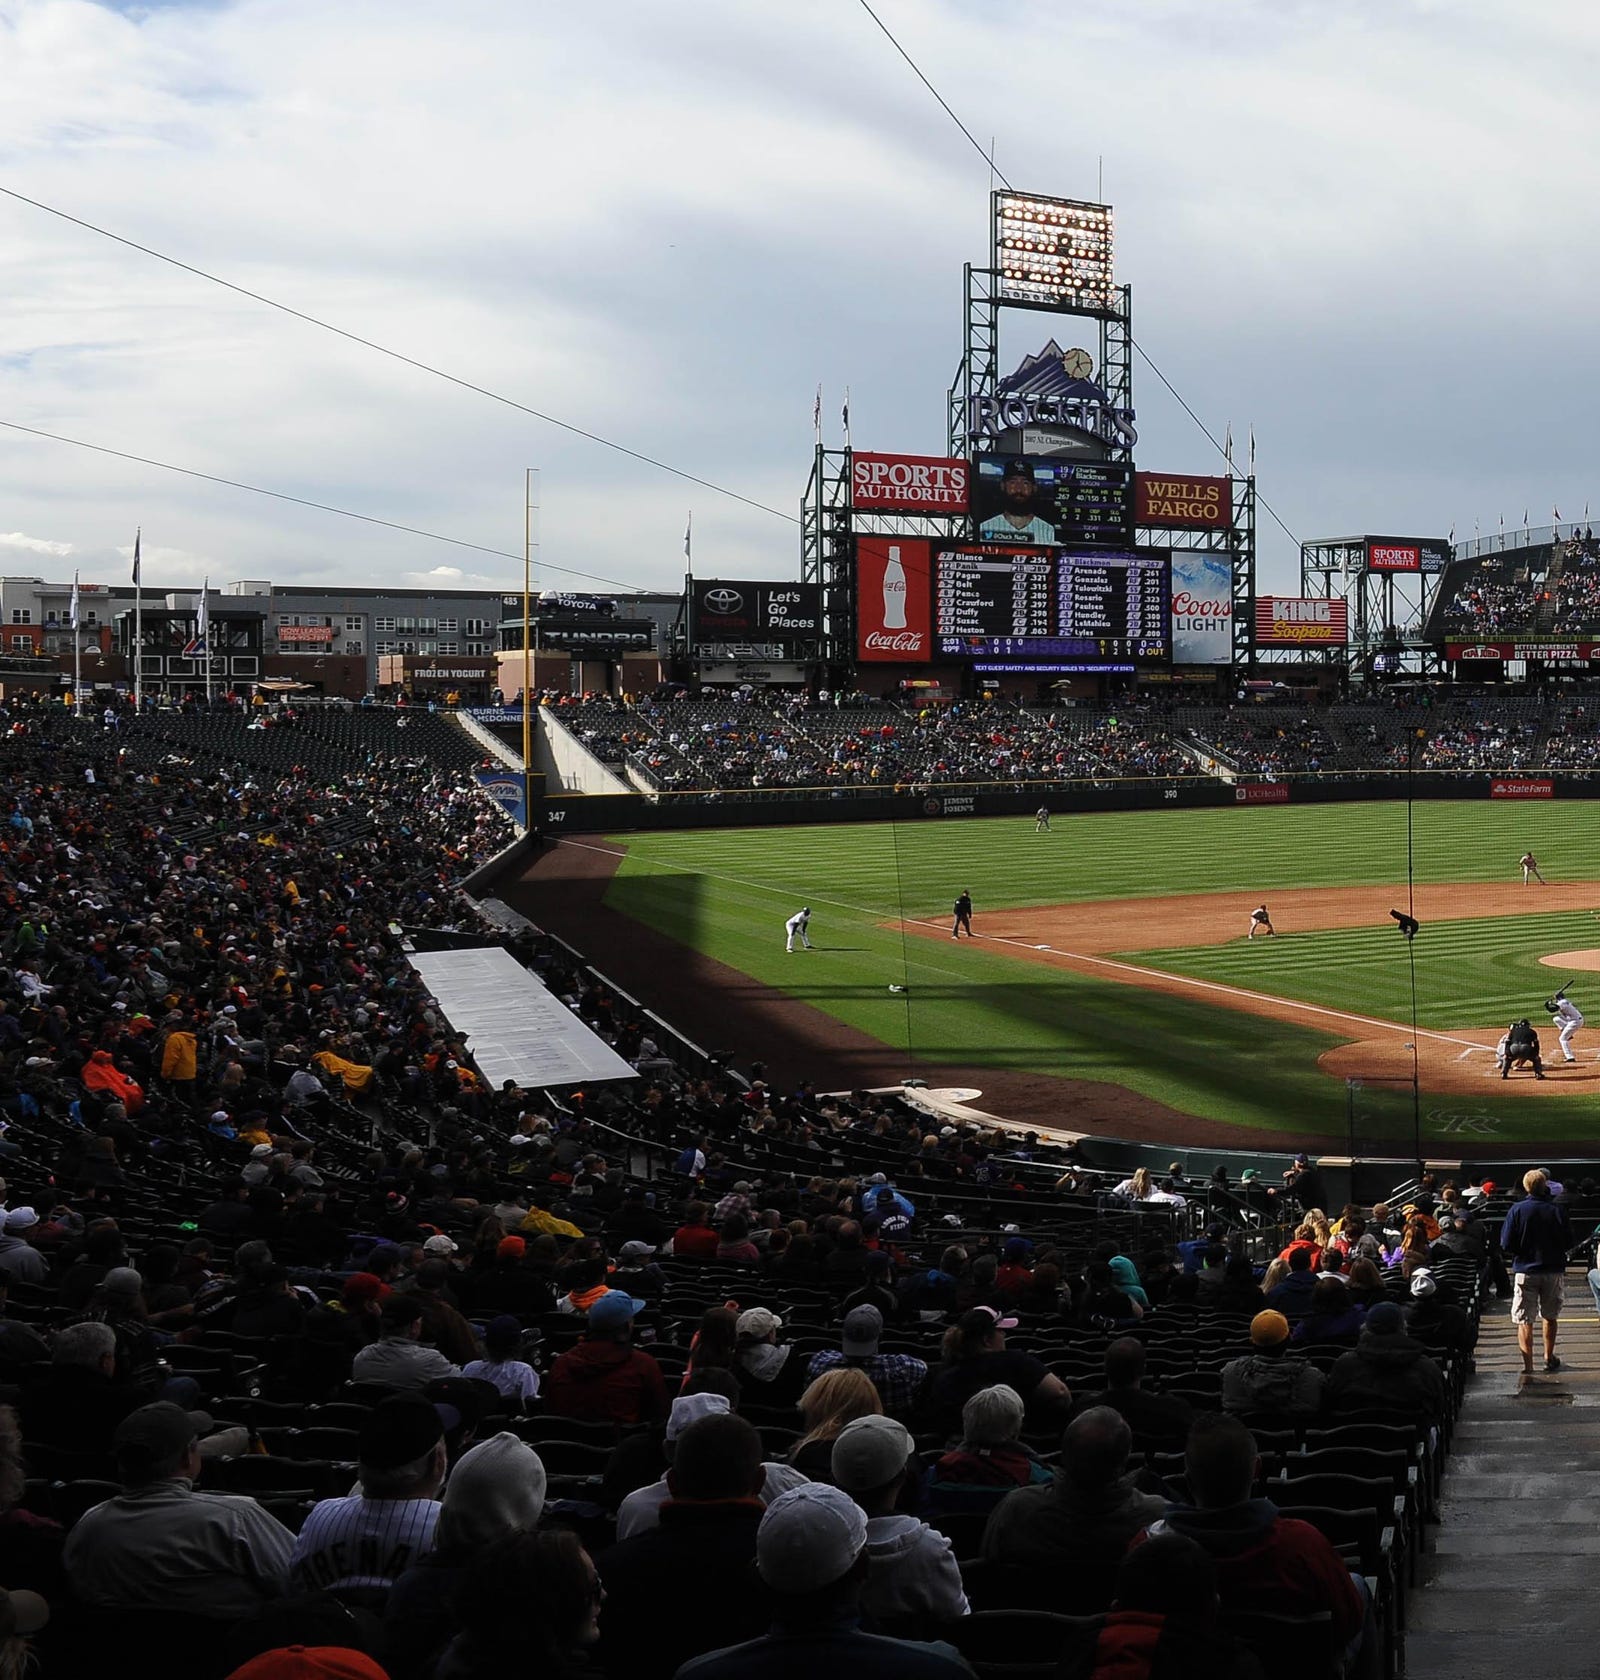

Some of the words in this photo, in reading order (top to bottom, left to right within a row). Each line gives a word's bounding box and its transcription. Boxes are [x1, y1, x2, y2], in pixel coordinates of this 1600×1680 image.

[967, 394, 1138, 449] ROCKIES
[855, 461, 965, 489] SPORTS
[1145, 481, 1219, 502] WELLS
[1146, 500, 1219, 519] FARGO
[1374, 548, 1415, 560] SPORTS
[956, 561, 978, 570] Panik
[956, 572, 981, 580] Pagan
[768, 590, 801, 603] Let's
[557, 599, 597, 610] TOYOTA
[956, 599, 994, 607] Crawford
[1171, 592, 1233, 617] Coors
[767, 603, 788, 615] Go
[956, 608, 979, 617] Duffy
[1272, 601, 1331, 621] KING
[768, 616, 815, 628] Places
[1176, 618, 1227, 632] LIGHT
[280, 627, 301, 635] NOW
[301, 627, 332, 635] LEASING
[956, 625, 985, 634] Heston
[1271, 621, 1332, 642] Soopers
[544, 631, 648, 644] TUNDRA
[865, 631, 925, 651] Coca-Cola
[1146, 648, 1164, 656] OUT
[1514, 650, 1549, 659] BETTER
[1551, 650, 1580, 659] PIZZA.
[414, 669, 449, 678] FROZEN
[450, 669, 486, 678] YOGURT
[1164, 789, 1178, 799] 390
[1248, 788, 1288, 798] UCHealth
[944, 797, 974, 805] JIMMY
[944, 805, 975, 814] JOHN'S
[548, 811, 566, 822] 347
